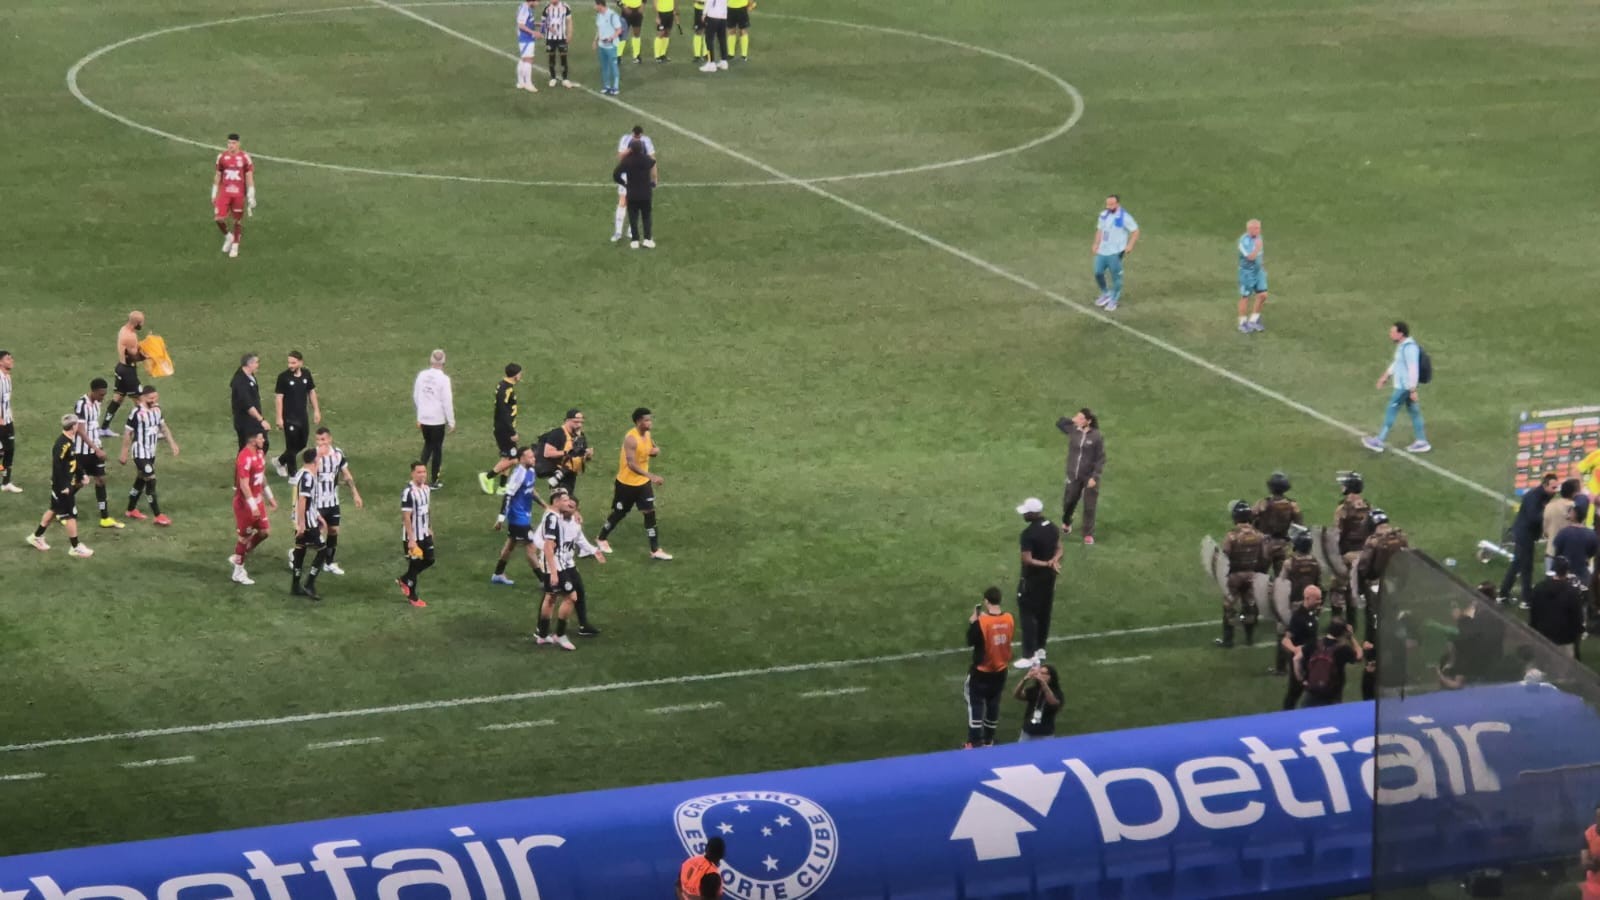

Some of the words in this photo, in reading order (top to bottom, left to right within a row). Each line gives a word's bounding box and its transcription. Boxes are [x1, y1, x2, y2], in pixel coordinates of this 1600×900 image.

[683, 792, 801, 819] CRUZEIRO
[1062, 713, 1511, 843] betfair
[685, 829, 788, 900] ESORTE
[796, 813, 832, 888] CLUBE
